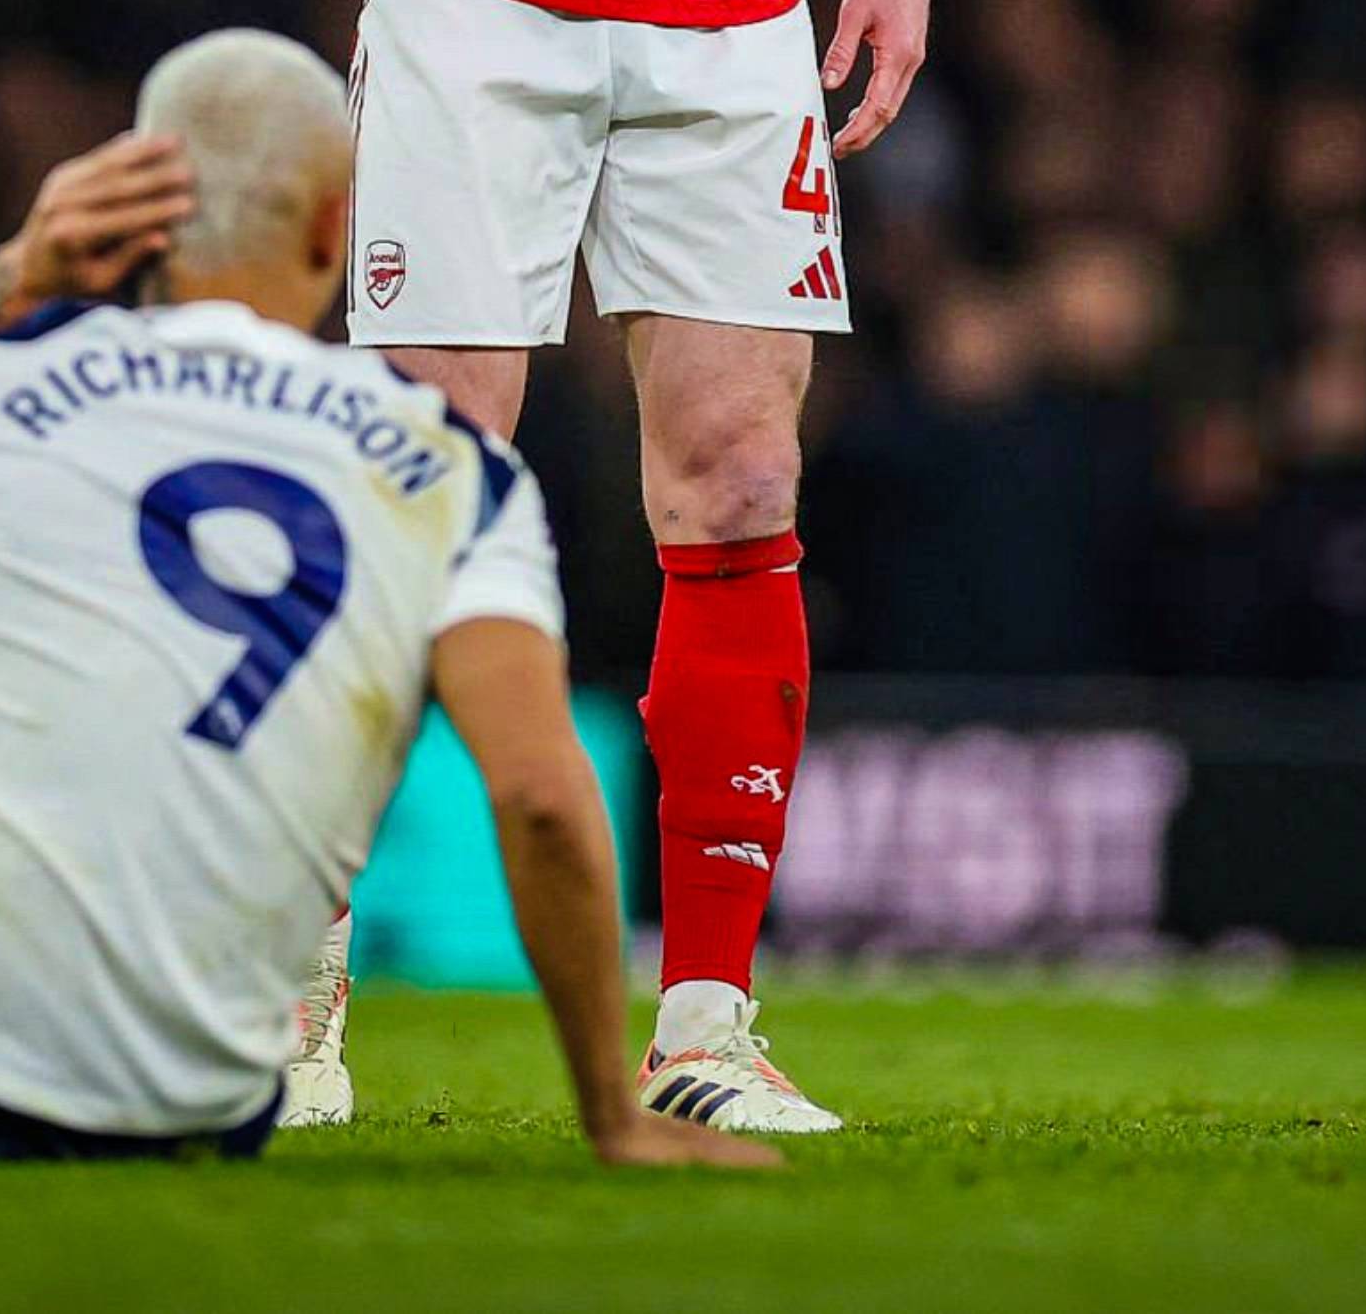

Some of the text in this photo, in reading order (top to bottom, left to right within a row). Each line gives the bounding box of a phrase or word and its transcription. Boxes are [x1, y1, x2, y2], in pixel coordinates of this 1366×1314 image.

[782, 116, 830, 233] 4
[1, 343, 451, 496] RICHARLISON
[138, 458, 349, 753] 9
